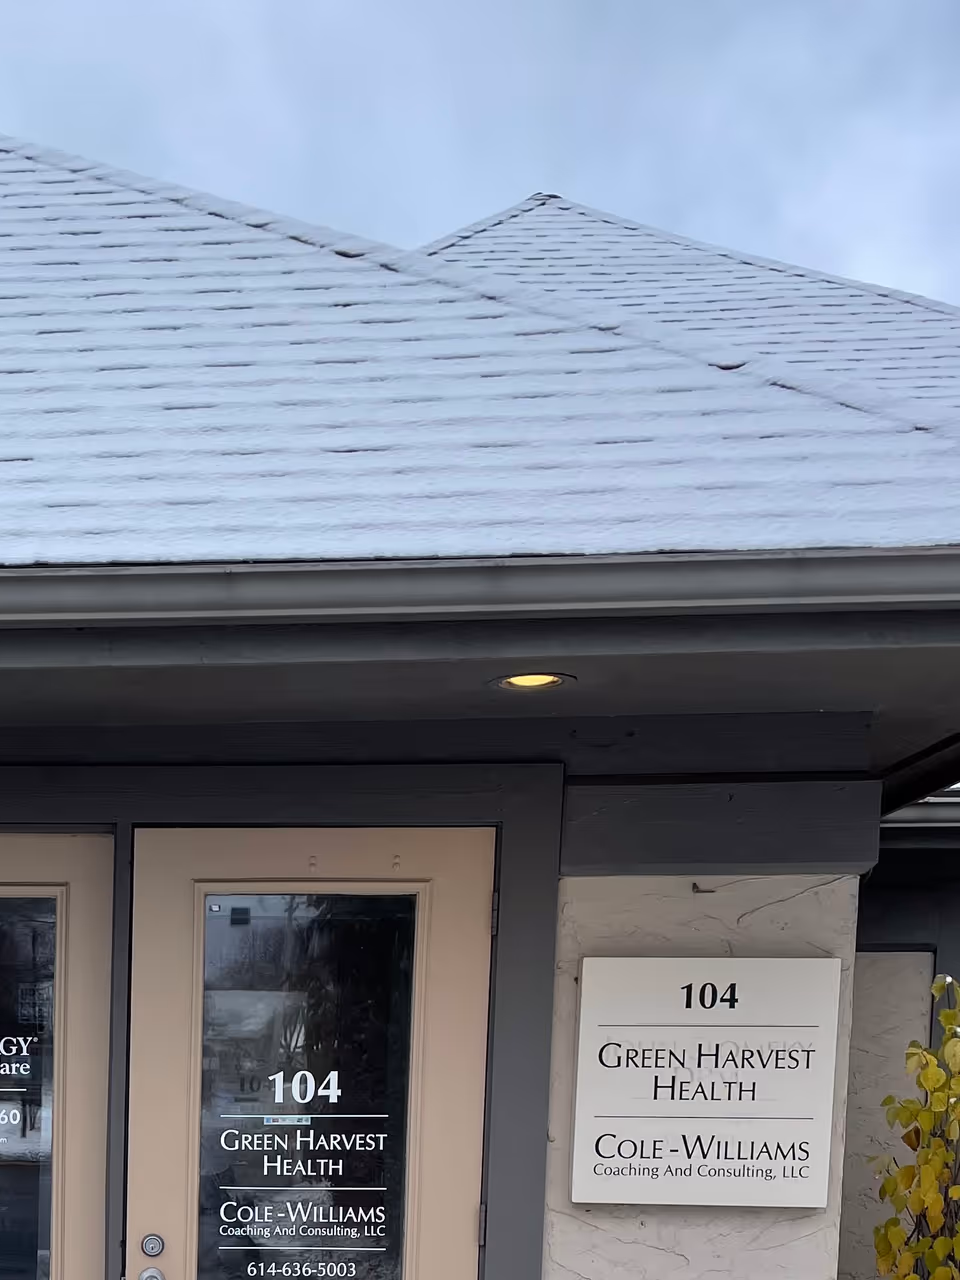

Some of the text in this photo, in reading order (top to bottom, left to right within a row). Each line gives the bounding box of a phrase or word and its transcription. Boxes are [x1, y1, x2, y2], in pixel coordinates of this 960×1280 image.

[681, 983, 739, 1009] 104
[598, 1043, 685, 1069] GREEN
[697, 1044, 815, 1069] HARVEST
[268, 1070, 342, 1103] 104
[653, 1075, 756, 1101] HEALTH
[220, 1130, 387, 1151] GREEN HARVEST
[264, 1155, 342, 1175] HEALTH
[594, 1164, 809, 1180] Coaching And Consulting, LLC
[220, 1226, 385, 1237] Coaching And Consulting, LLC
[248, 1263, 356, 1276] 614-636-5003
